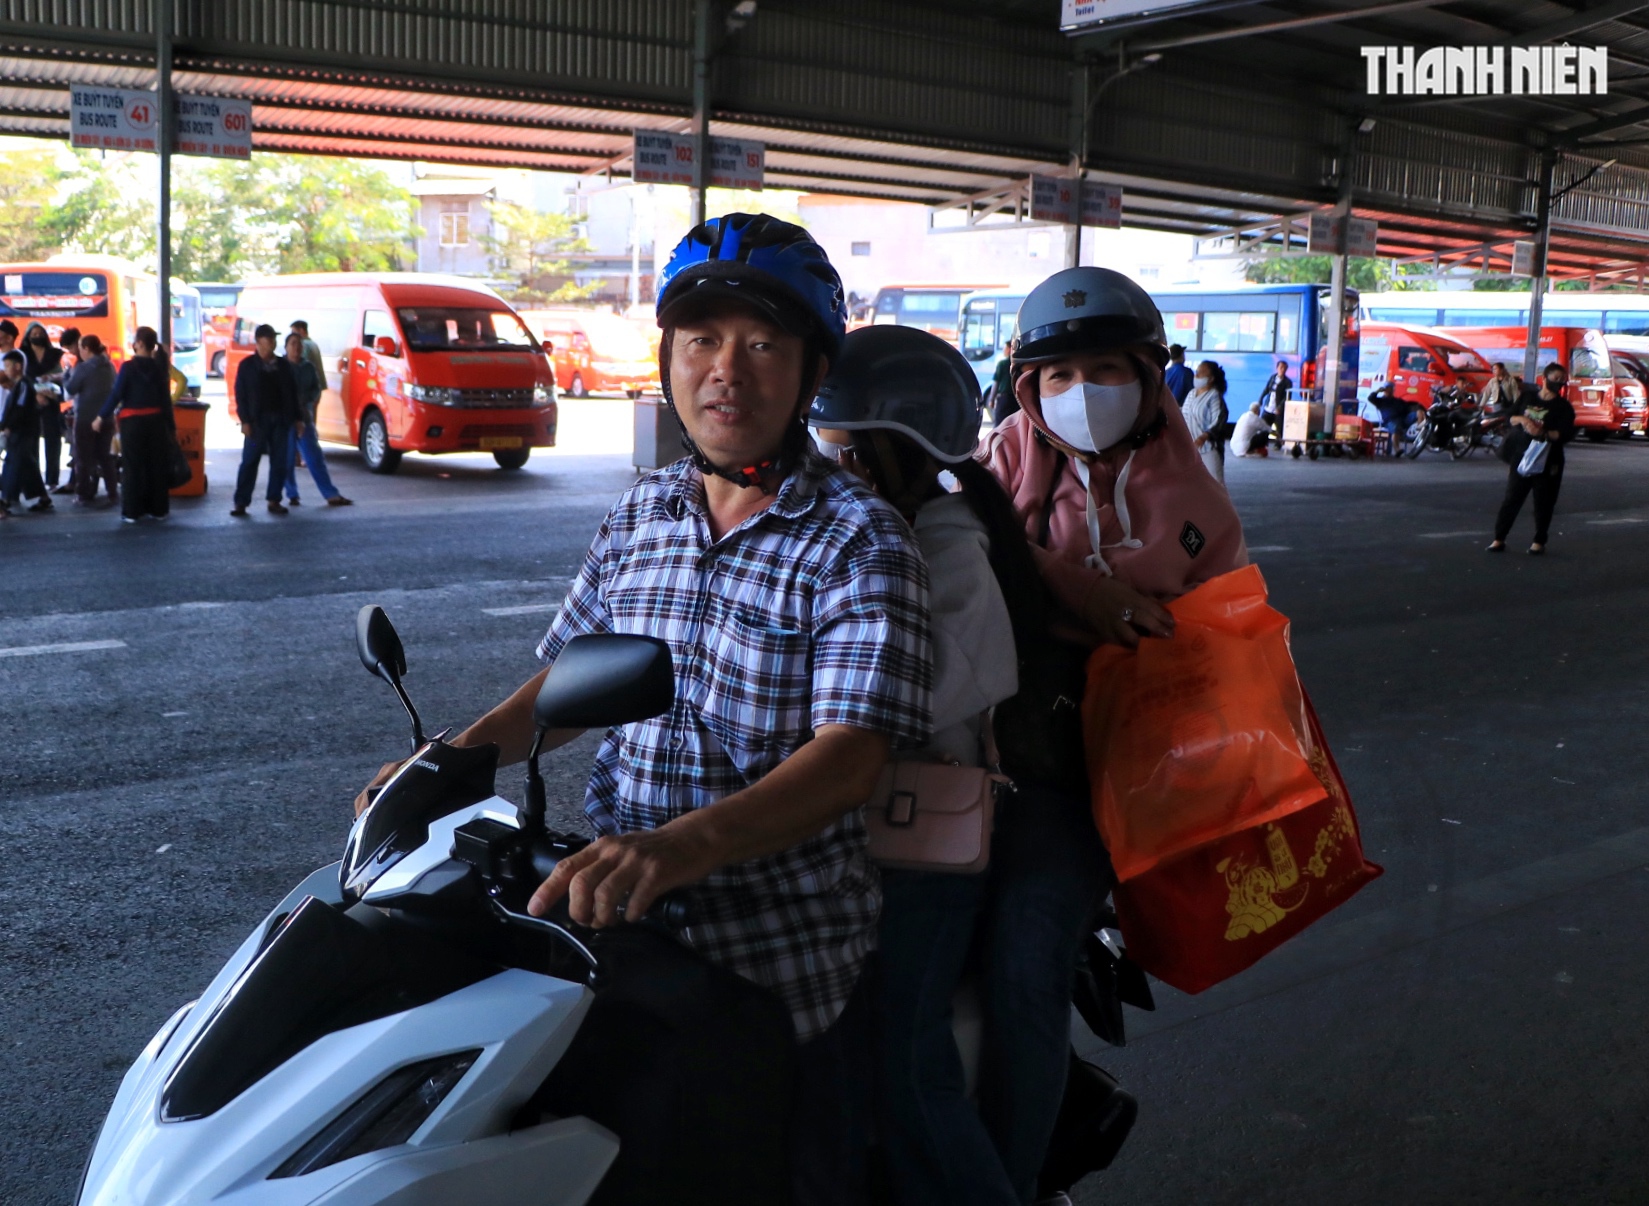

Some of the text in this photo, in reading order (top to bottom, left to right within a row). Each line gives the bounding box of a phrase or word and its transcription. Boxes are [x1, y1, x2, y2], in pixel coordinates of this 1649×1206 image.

[73, 92, 82, 107] XE
[80, 112, 117, 128] BUS ROUTE
[130, 105, 149, 124] 41
[225, 112, 246, 132] 601
[192, 120, 214, 136] ROUTE
[675, 146, 693, 163] 102
[746, 152, 760, 168] 151
